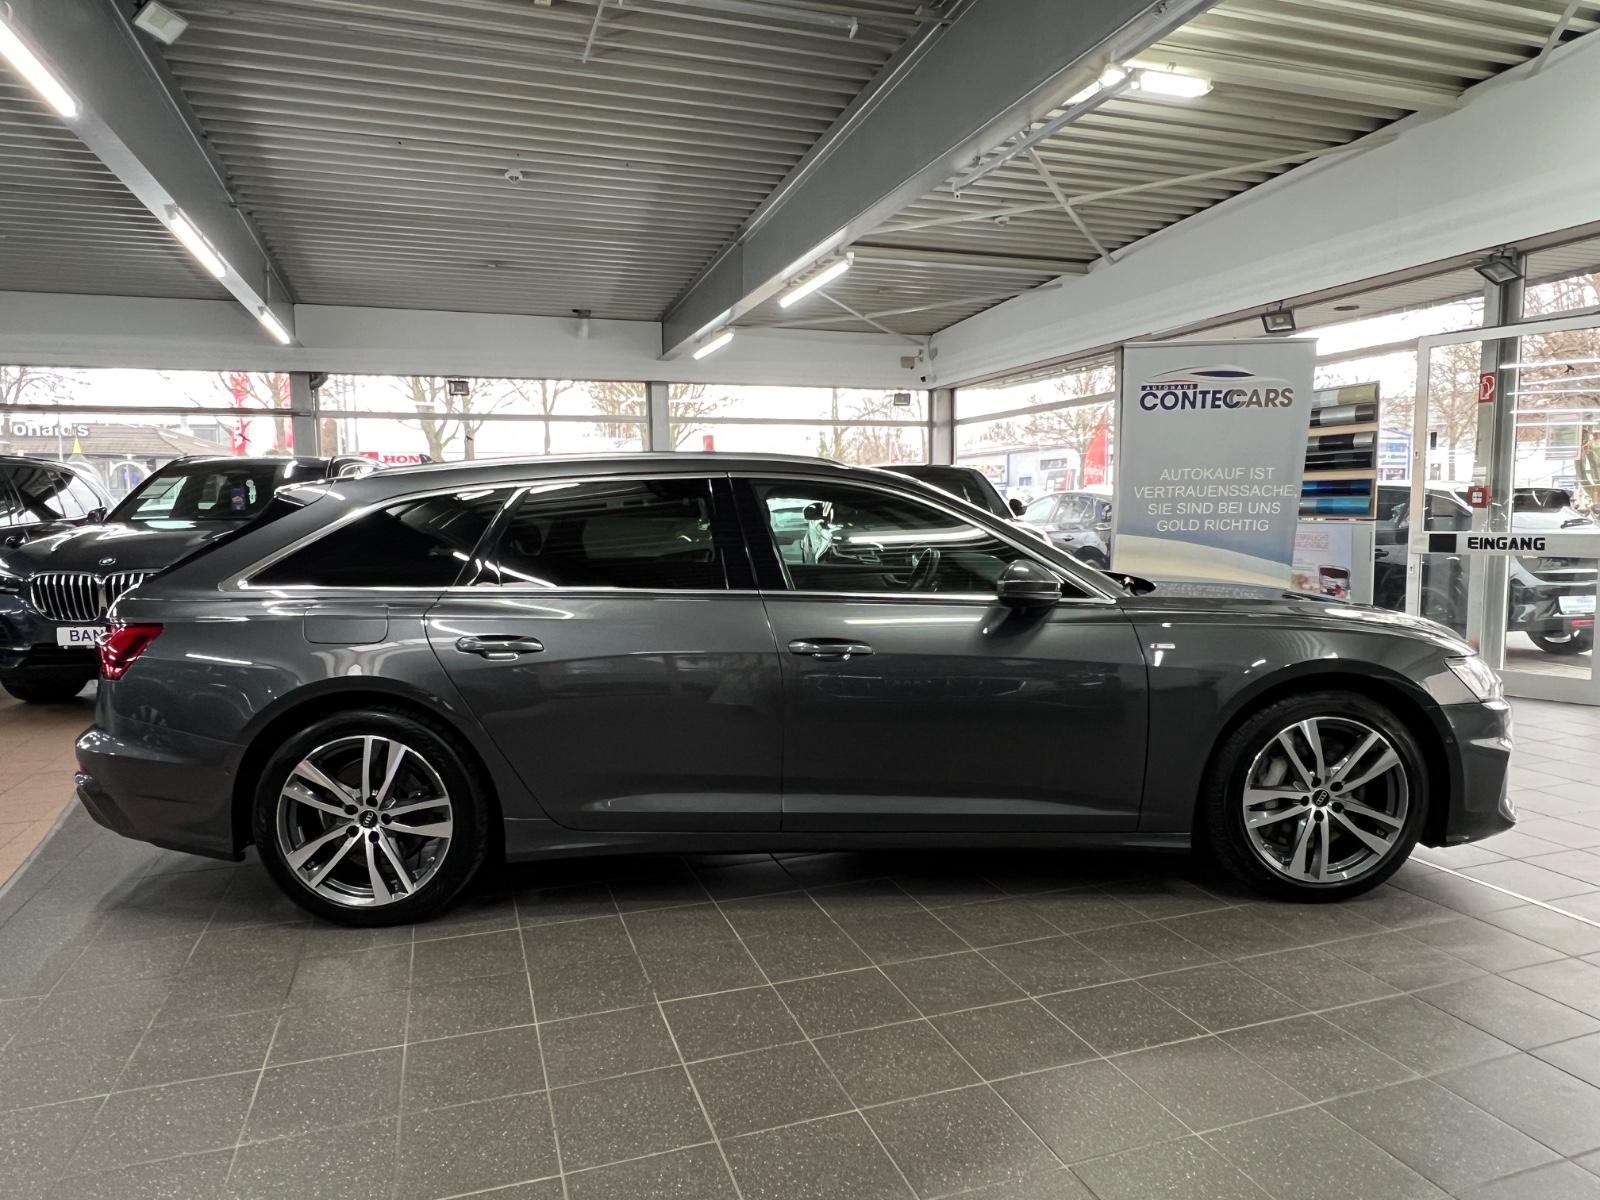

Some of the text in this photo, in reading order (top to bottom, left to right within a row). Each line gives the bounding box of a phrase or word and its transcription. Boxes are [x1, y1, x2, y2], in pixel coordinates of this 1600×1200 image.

[1159, 467, 1275, 481] AUTOKAUF IST
[1133, 484, 1298, 499] VERTRAUENSSACHE,
[1147, 501, 1281, 515] SIE SIND BEI UNS
[1156, 519, 1269, 532] GOLD RICHTIG
[1467, 536, 1546, 551] EINGANG
